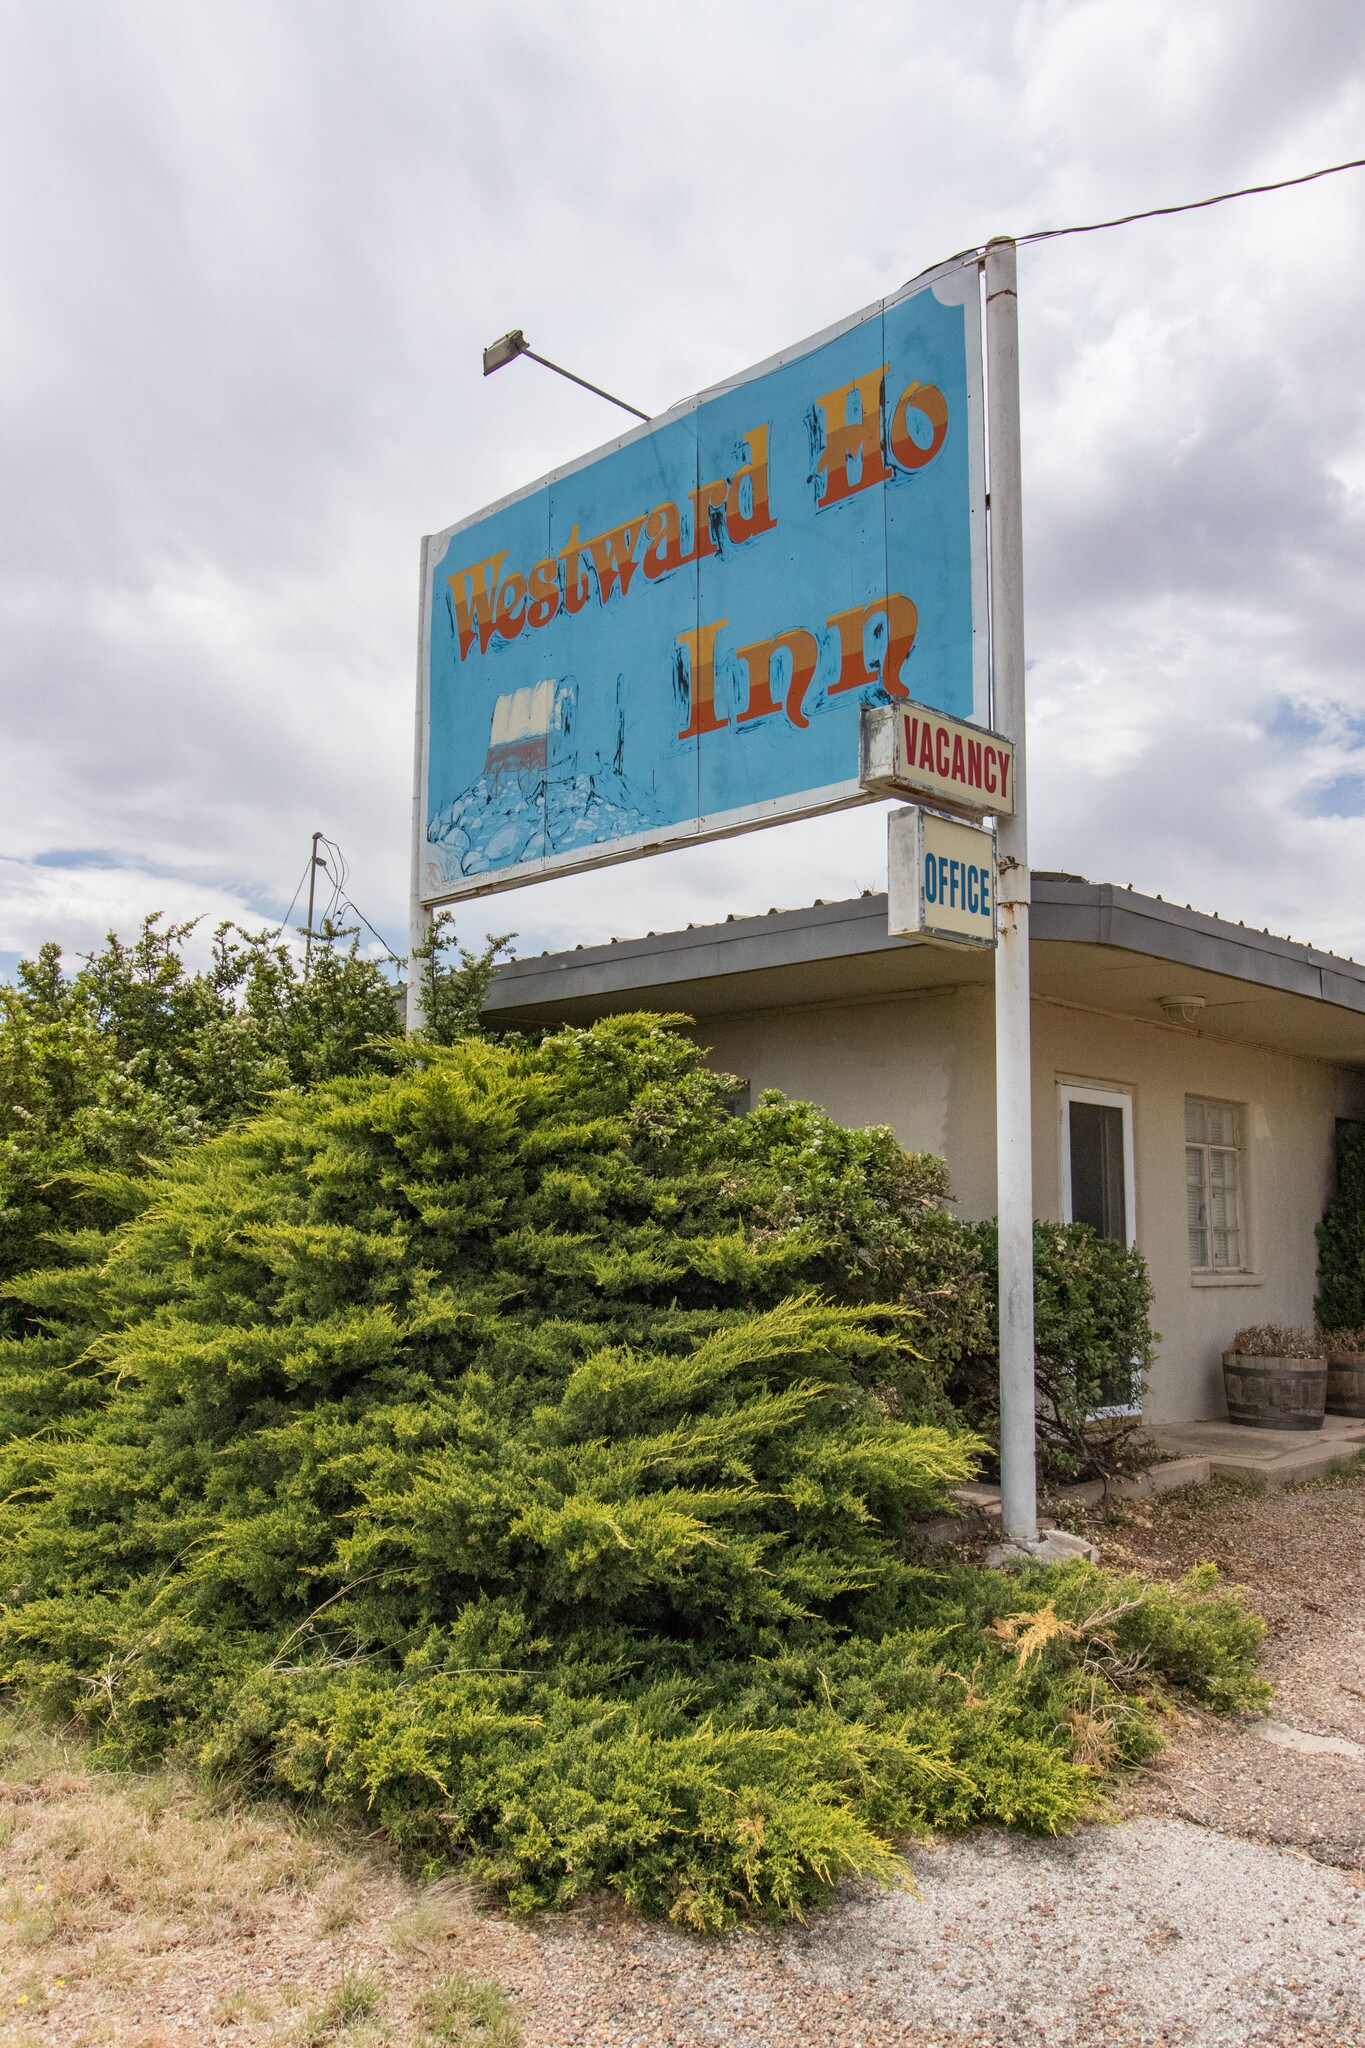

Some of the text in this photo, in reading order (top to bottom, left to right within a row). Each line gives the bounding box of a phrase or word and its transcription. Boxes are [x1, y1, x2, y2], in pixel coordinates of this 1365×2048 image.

[446, 363, 949, 662] Westward Ho
[677, 593, 919, 741] Inn
[904, 714, 1010, 798] VACANCY
[924, 852, 991, 917] OFFICE
